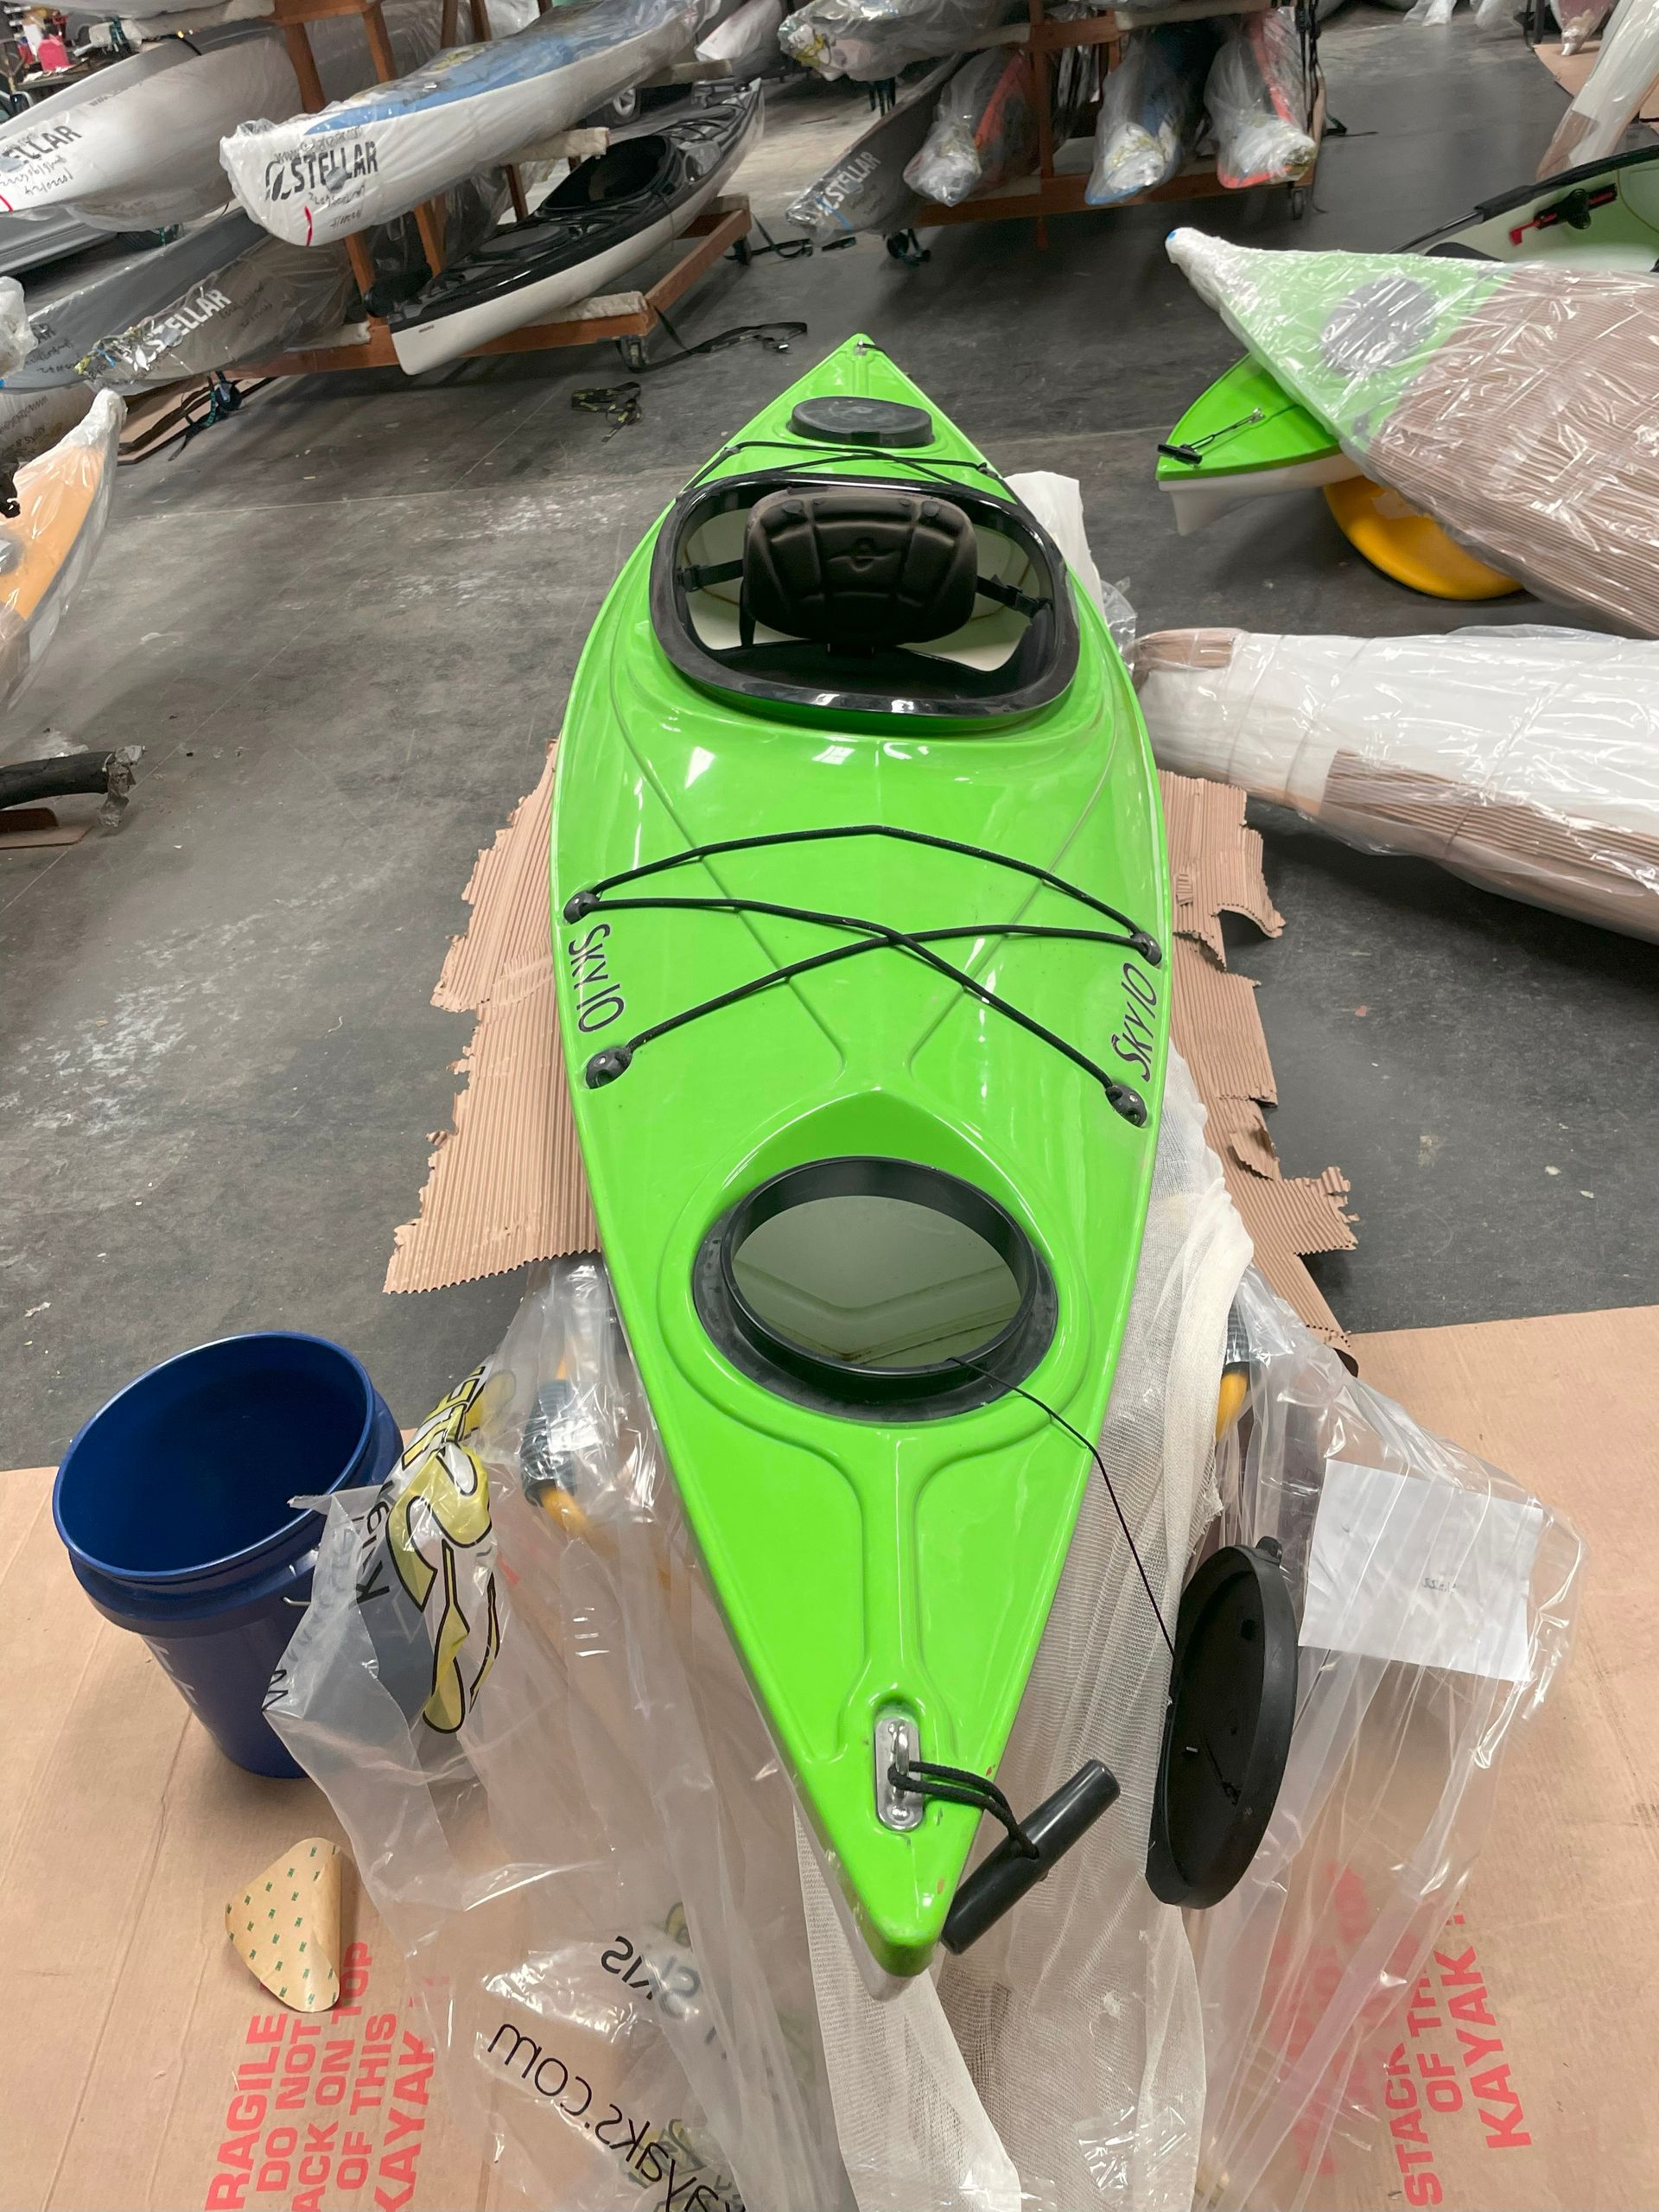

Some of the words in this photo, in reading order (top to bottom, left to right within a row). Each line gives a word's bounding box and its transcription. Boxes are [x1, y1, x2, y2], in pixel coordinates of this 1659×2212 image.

[290, 141, 378, 193] STELLAR
[331, 1942, 373, 2024] TOP
[275, 2018, 321, 2110] NOT
[315, 2039, 355, 2106] ON
[349, 2012, 397, 2116] THIS
[1417, 2053, 1464, 2113] OF
[1433, 1946, 1533, 2149] KAYAK
[205, 2012, 288, 2212] RAGILE
[256, 2126, 298, 2192] DO
[336, 2132, 373, 2190] OF
